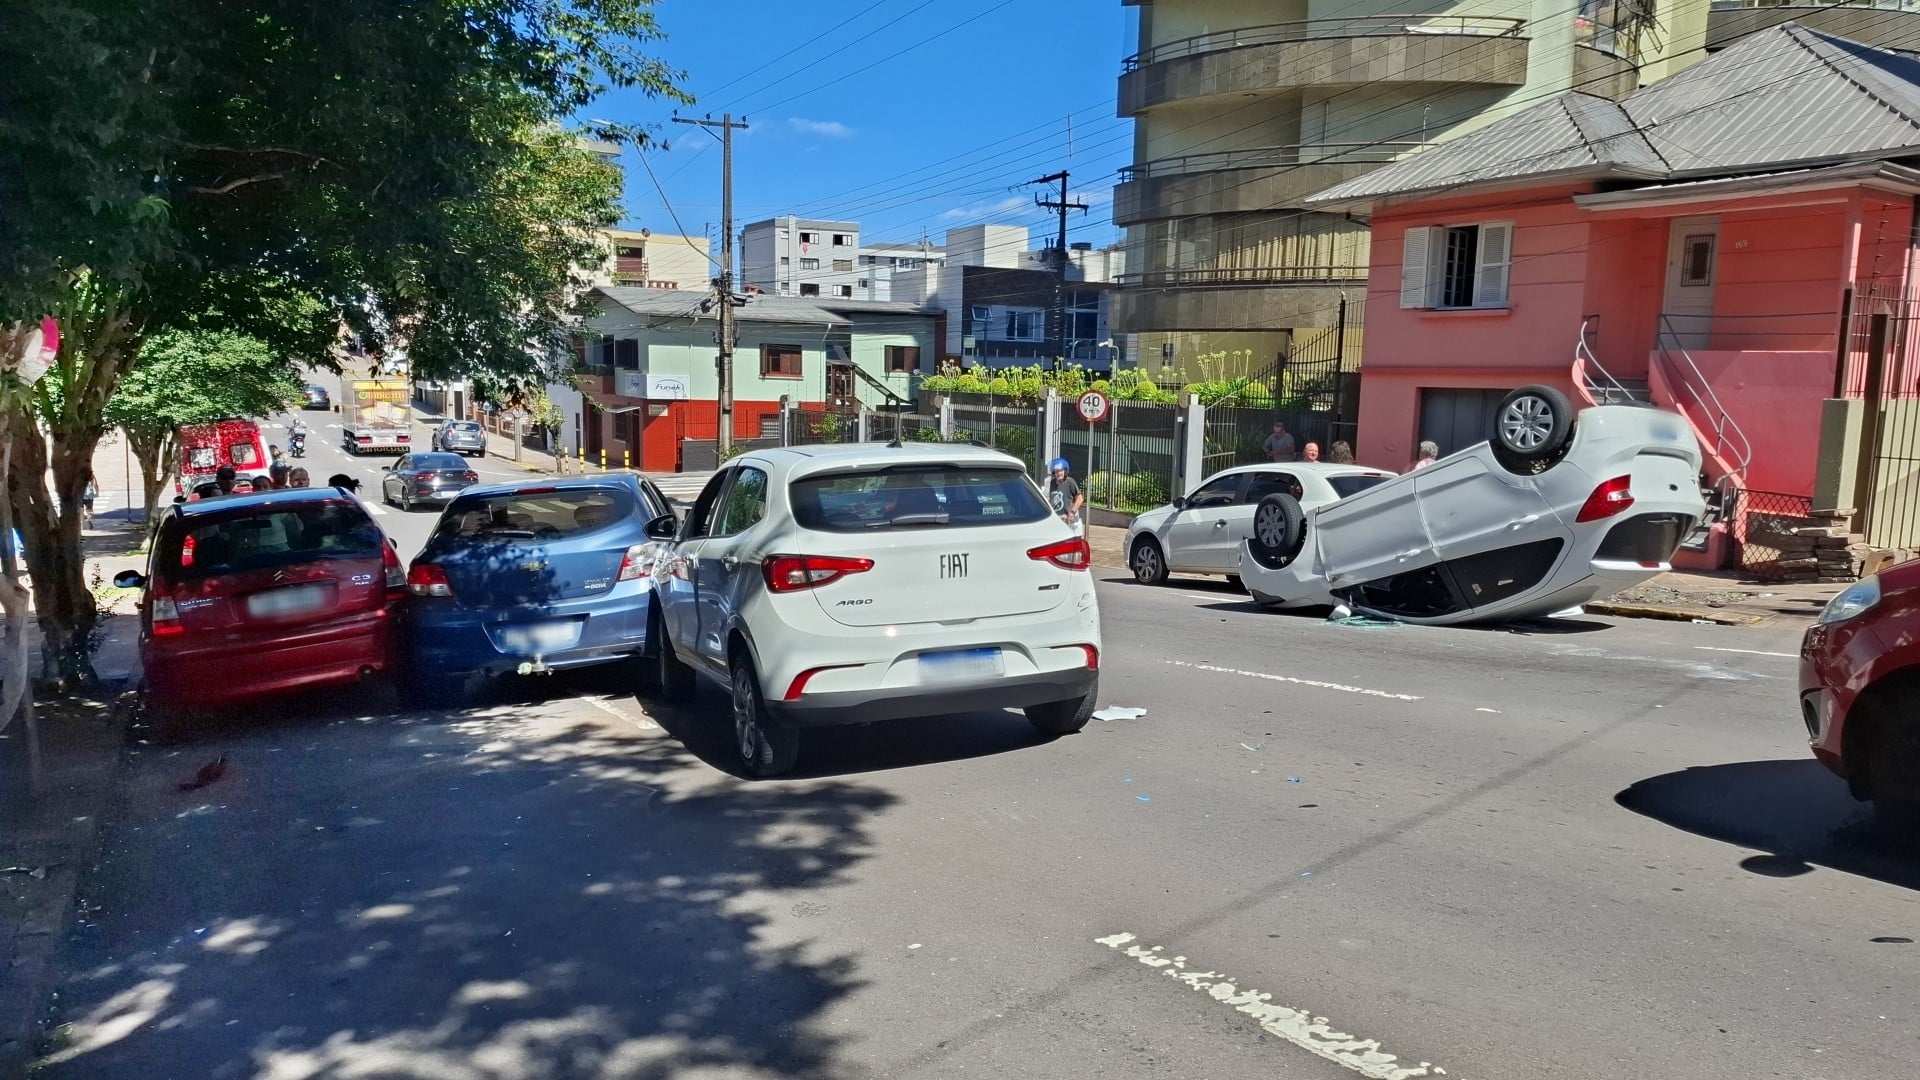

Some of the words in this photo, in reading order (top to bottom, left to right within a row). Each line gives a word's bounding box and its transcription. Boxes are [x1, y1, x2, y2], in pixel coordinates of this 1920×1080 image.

[1083, 396, 1100, 407] 40
[939, 552, 970, 580] FIAT
[835, 598, 873, 607] ARGO
